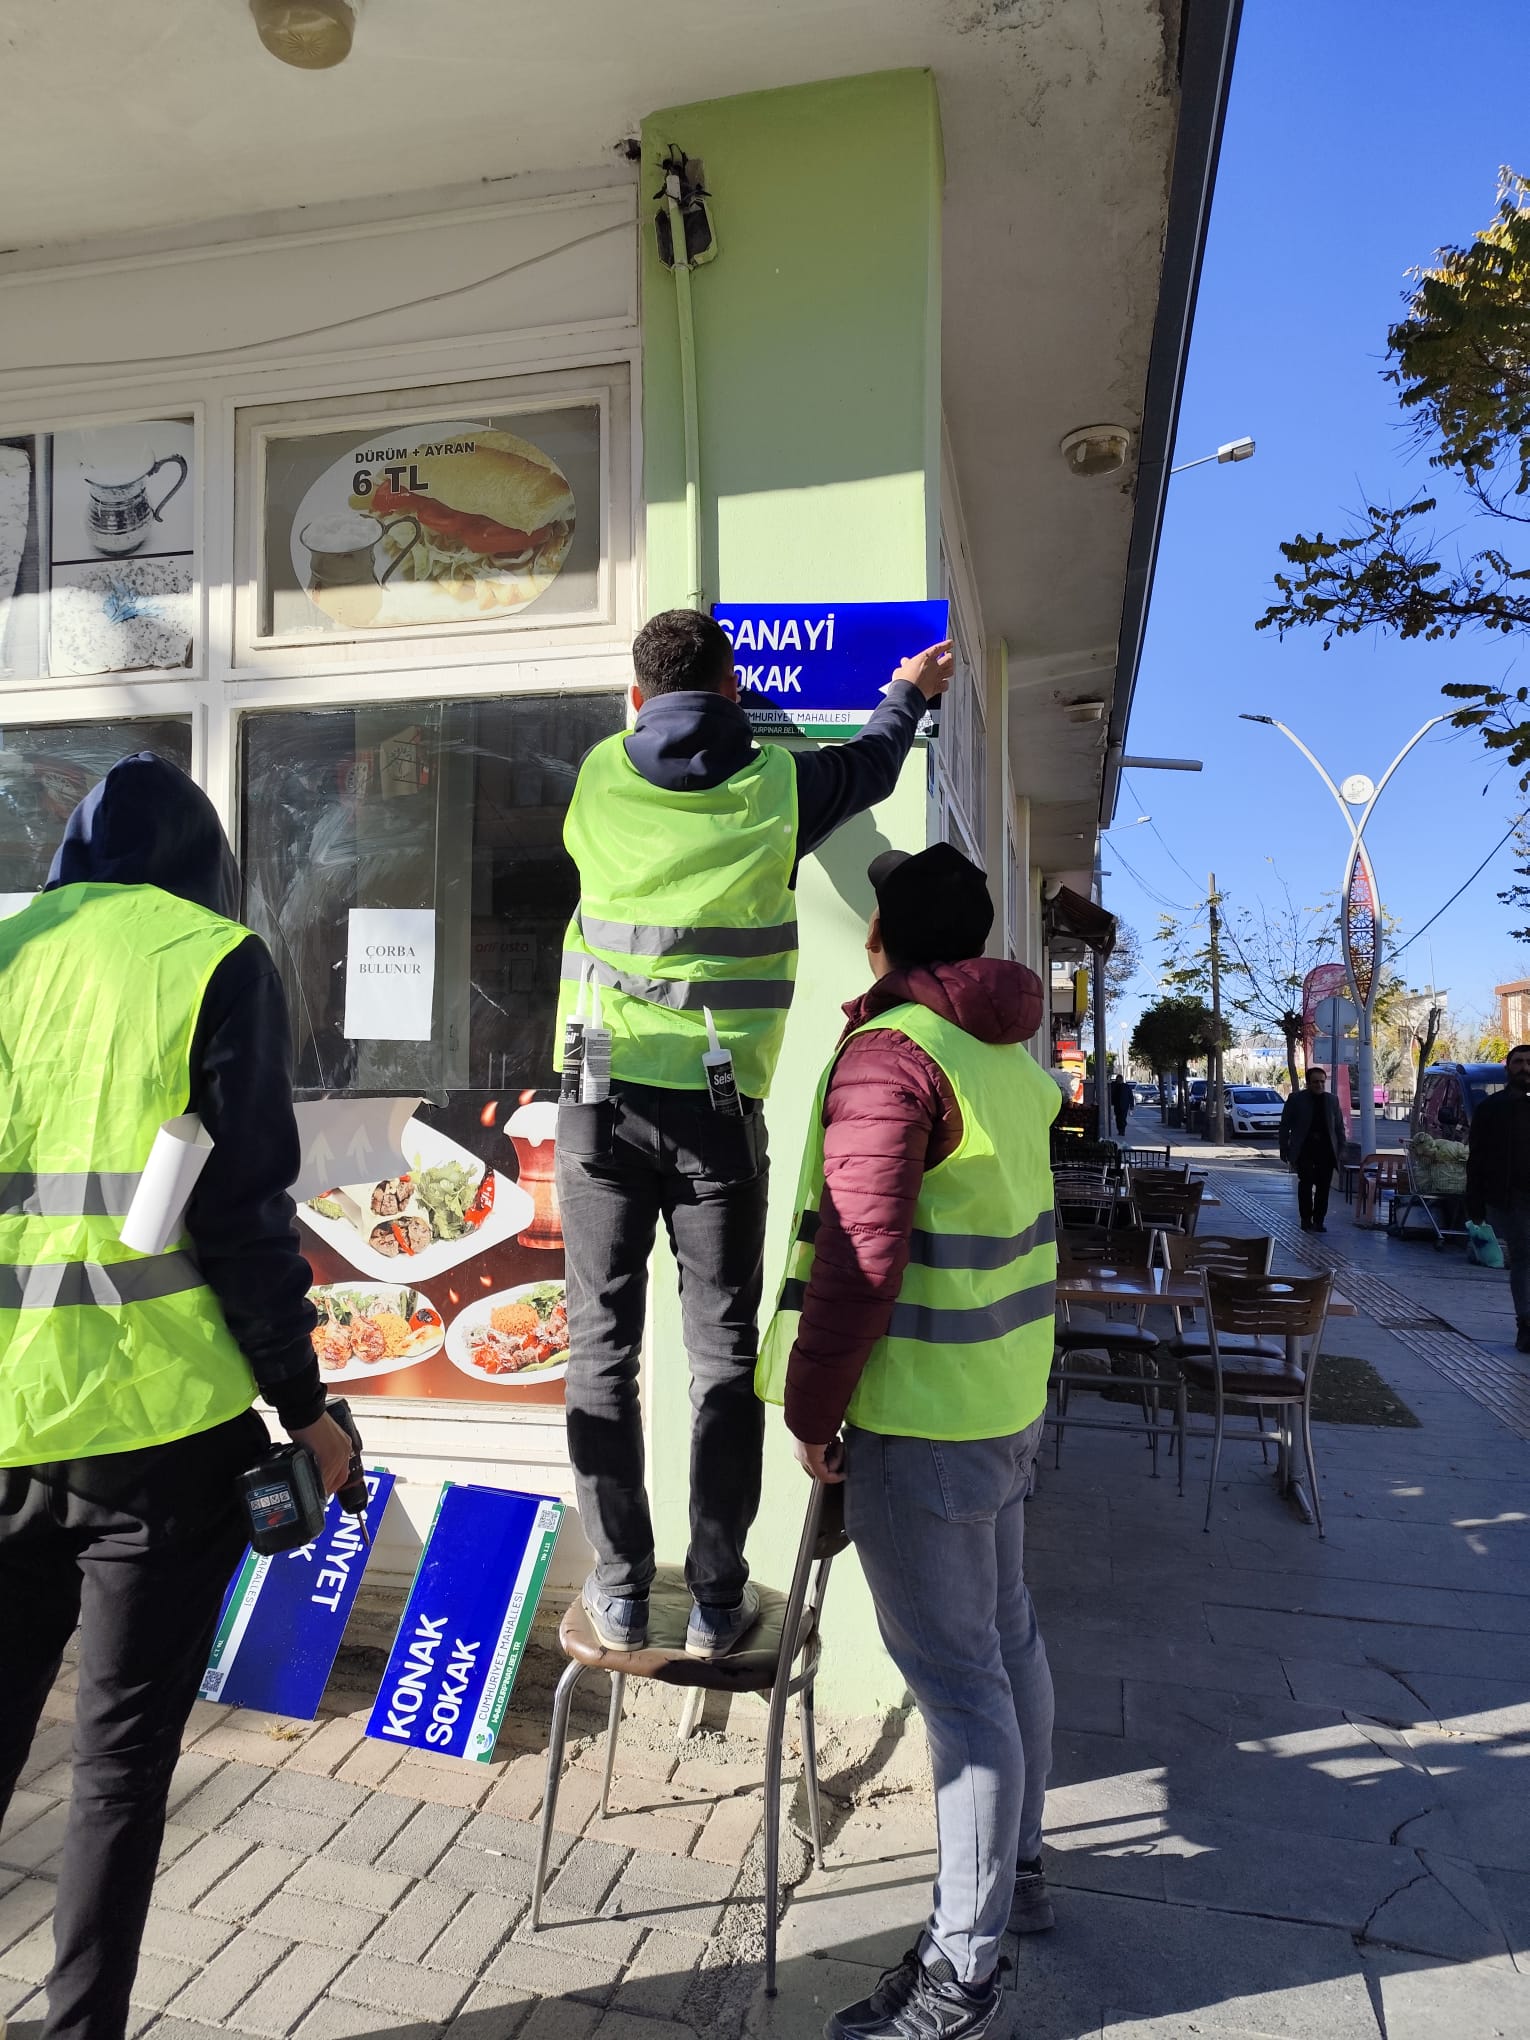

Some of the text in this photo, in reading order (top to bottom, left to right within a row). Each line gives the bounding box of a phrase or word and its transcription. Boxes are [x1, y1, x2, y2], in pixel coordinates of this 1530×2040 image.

[355, 448, 407, 463] DÜRÜM
[425, 441, 475, 457] AYRAN
[352, 464, 429, 496] 6 TL
[718, 613, 835, 650] SANAYİ
[733, 664, 803, 693] OKAK
[746, 710, 850, 723] MHURİYET MAHALLESİ
[365, 945, 416, 958] ÇORBA
[359, 963, 421, 974] BULUNUR
[478, 1591, 525, 1721] CUMHURİYET MAHALLESİ
[382, 1613, 448, 1739] KONAK
[425, 1638, 480, 1746] SOKAK
